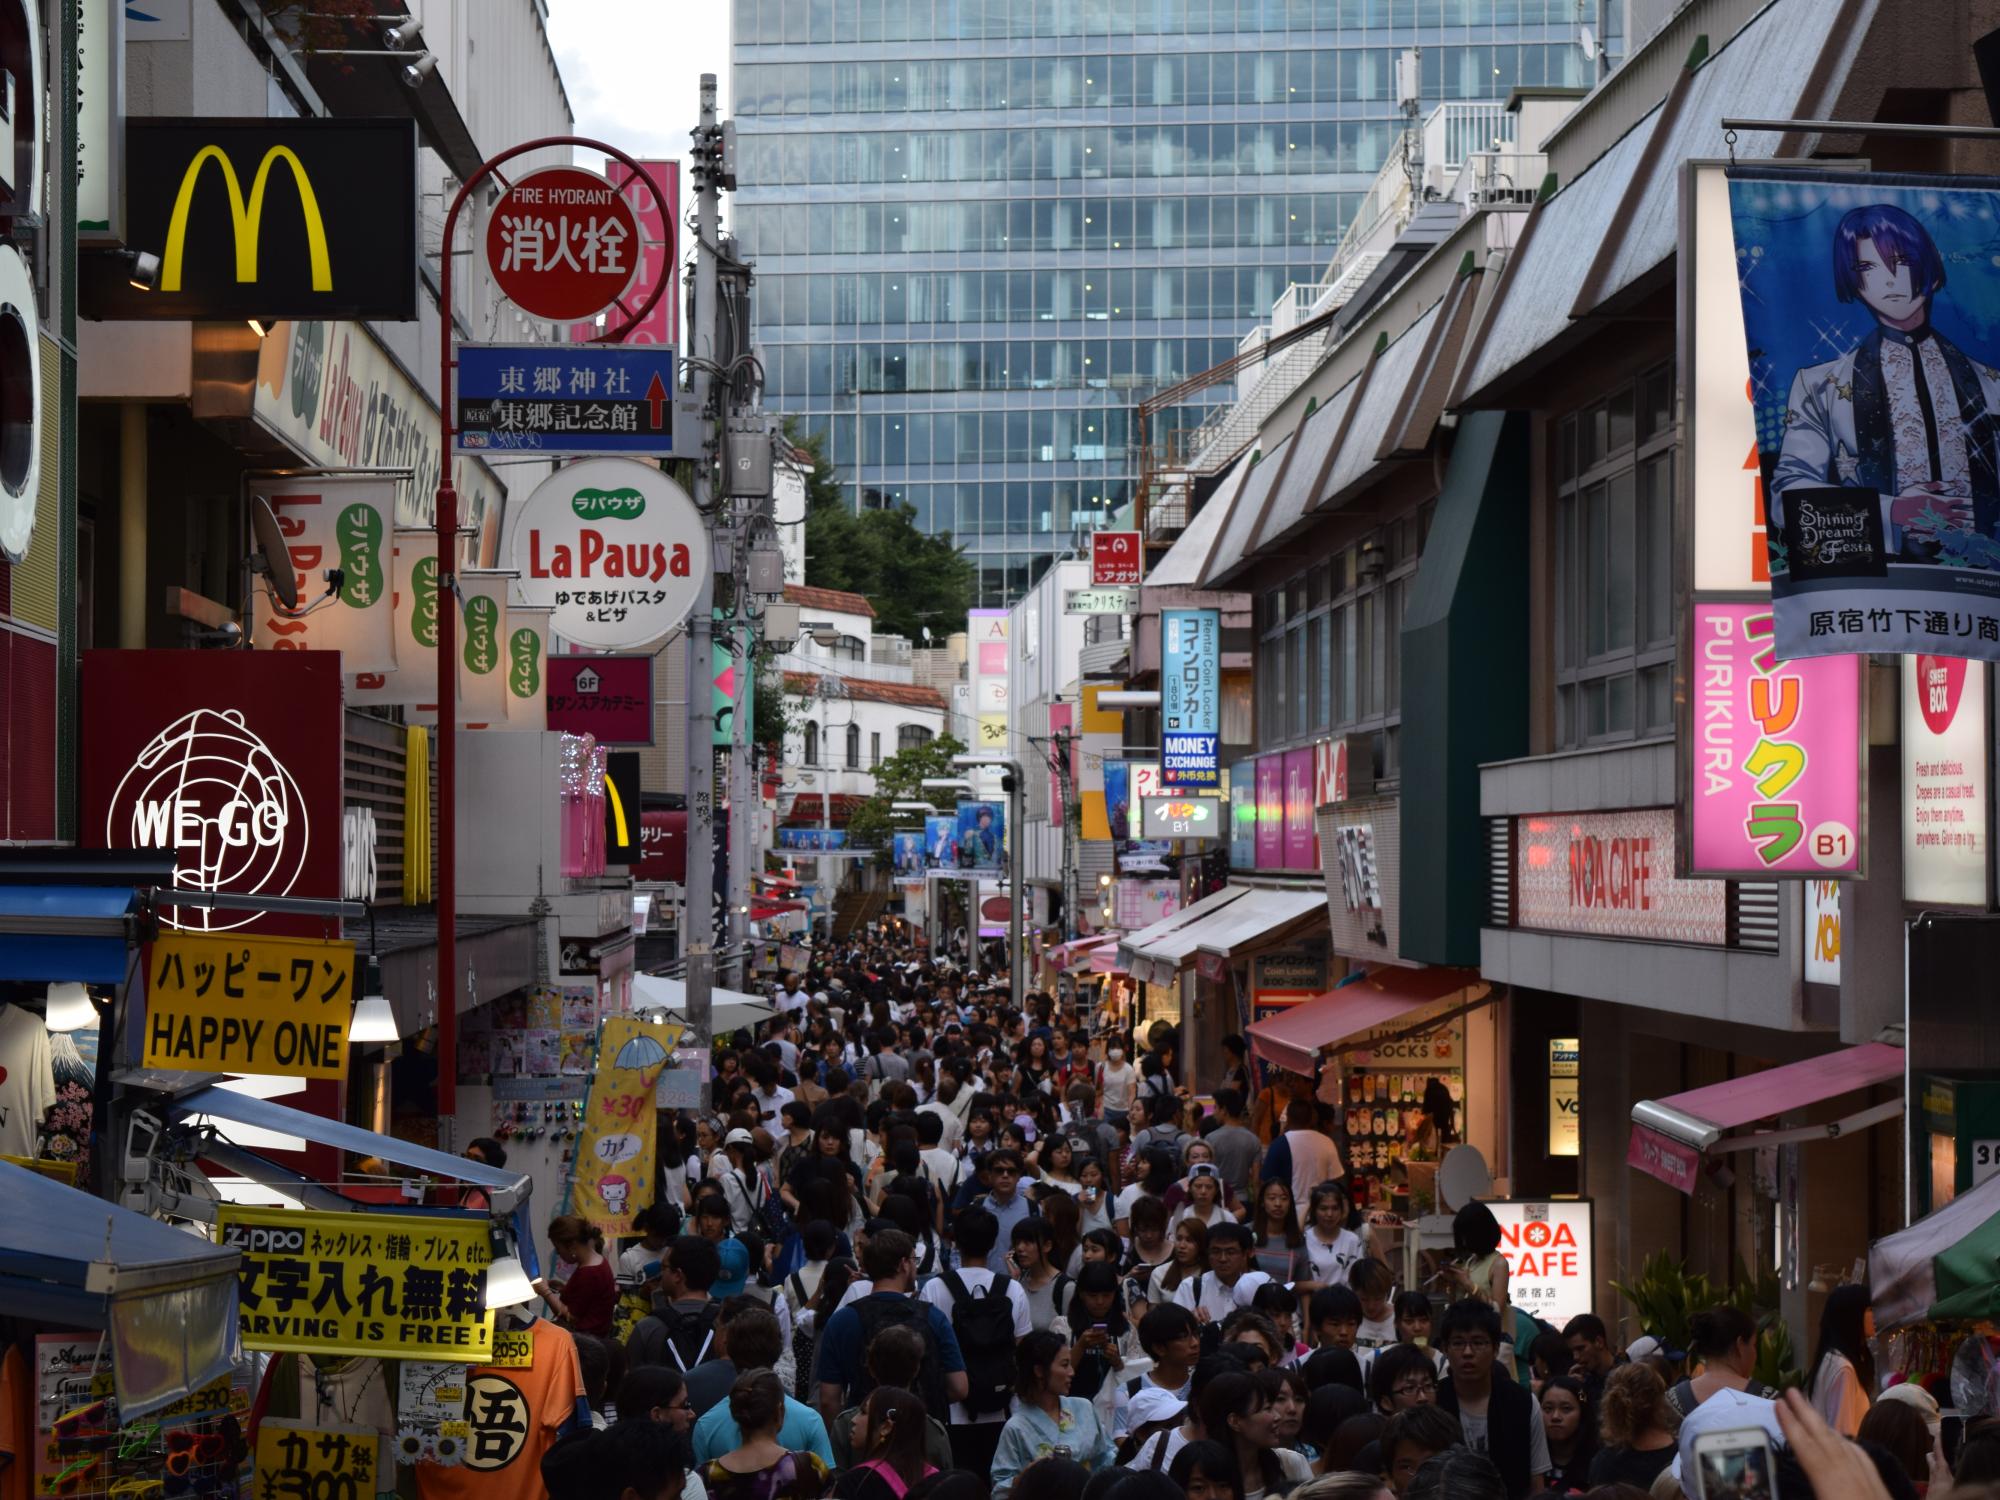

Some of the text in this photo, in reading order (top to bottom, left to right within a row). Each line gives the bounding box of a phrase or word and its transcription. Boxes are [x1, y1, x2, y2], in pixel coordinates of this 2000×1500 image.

[512, 187, 614, 206] FIRE HYDRANT
[500, 215, 629, 274] 消火栓
[498, 366, 632, 395] 東郷神社
[498, 402, 638, 432] 東郷記念館
[575, 495, 643, 512] ラパウザ
[1799, 501, 1869, 532] Shining
[1801, 526, 1859, 549] Dream
[1819, 539, 1873, 563] Festa
[350, 508, 371, 605] ラパウザ
[1104, 571, 1139, 582] アガサ
[555, 590, 667, 605] ゆであげパスタ
[1094, 595, 1137, 611] クリスティー
[586, 608, 628, 622] &ピザ
[1809, 608, 2000, 643] 原宿竹下通り商
[474, 599, 489, 673] ラパウザ
[518, 631, 532, 696] ラパウザ
[1183, 618, 1200, 729] コインロッカー
[1203, 618, 1214, 731] Rental Coin Locker
[1929, 667, 1948, 686] SWEET
[578, 677, 597, 690] 6F
[1704, 616, 1734, 796] PURIKURA
[1929, 686, 1949, 714] BOX
[1165, 737, 1216, 754] MONEY
[1165, 756, 1216, 769] EXCHANGE
[1916, 761, 1930, 777] Fresh
[1930, 761, 1940, 777] and
[1916, 784, 1932, 803] Crepes
[136, 801, 285, 848] WE GO
[1173, 820, 1189, 833] B1
[1916, 807, 1930, 826] Enjoy
[1817, 834, 1847, 856] B1
[1570, 836, 1650, 911] NOA CAFE
[157, 949, 347, 1004] ハッピーワン
[1264, 967, 1317, 976] Coin Locker
[151, 1013, 342, 1068] HAPPY ONE
[1373, 1044, 1429, 1058] SOCKS
[225, 1226, 304, 1253] Zippo
[1497, 1222, 1577, 1249] NOA
[240, 1256, 488, 1324] 文字入れ無料
[1517, 1288, 1556, 1299] 原宿店
[241, 1315, 339, 1339] ARVING
[356, 1321, 385, 1342] IS
[277, 1431, 374, 1484] カサ 税込
